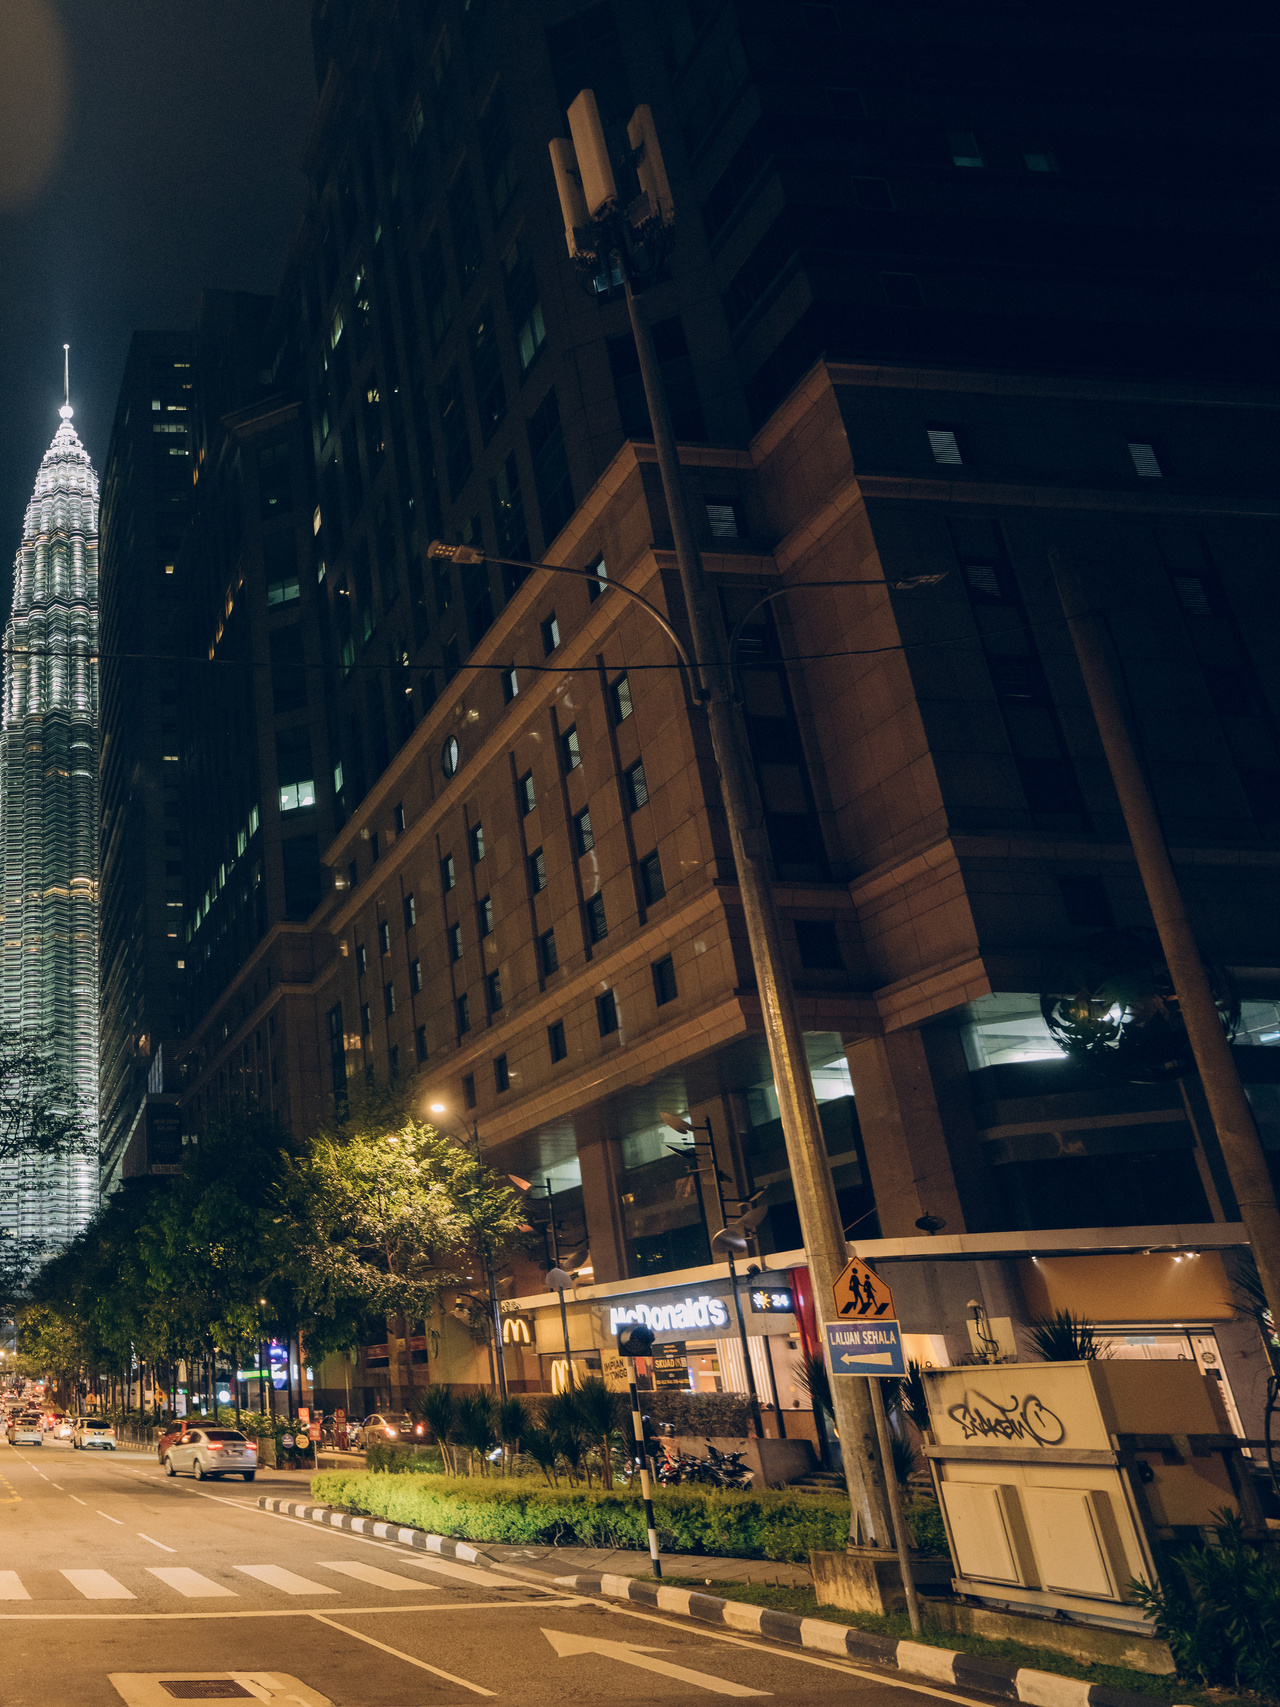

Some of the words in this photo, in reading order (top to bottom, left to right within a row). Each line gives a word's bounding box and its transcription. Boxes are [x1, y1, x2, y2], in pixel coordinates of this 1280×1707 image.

[771, 1294, 789, 1307] 24
[610, 1296, 728, 1335] McDonald's
[829, 1331, 861, 1346] LALUAN
[862, 1330, 897, 1345] SEHALA
